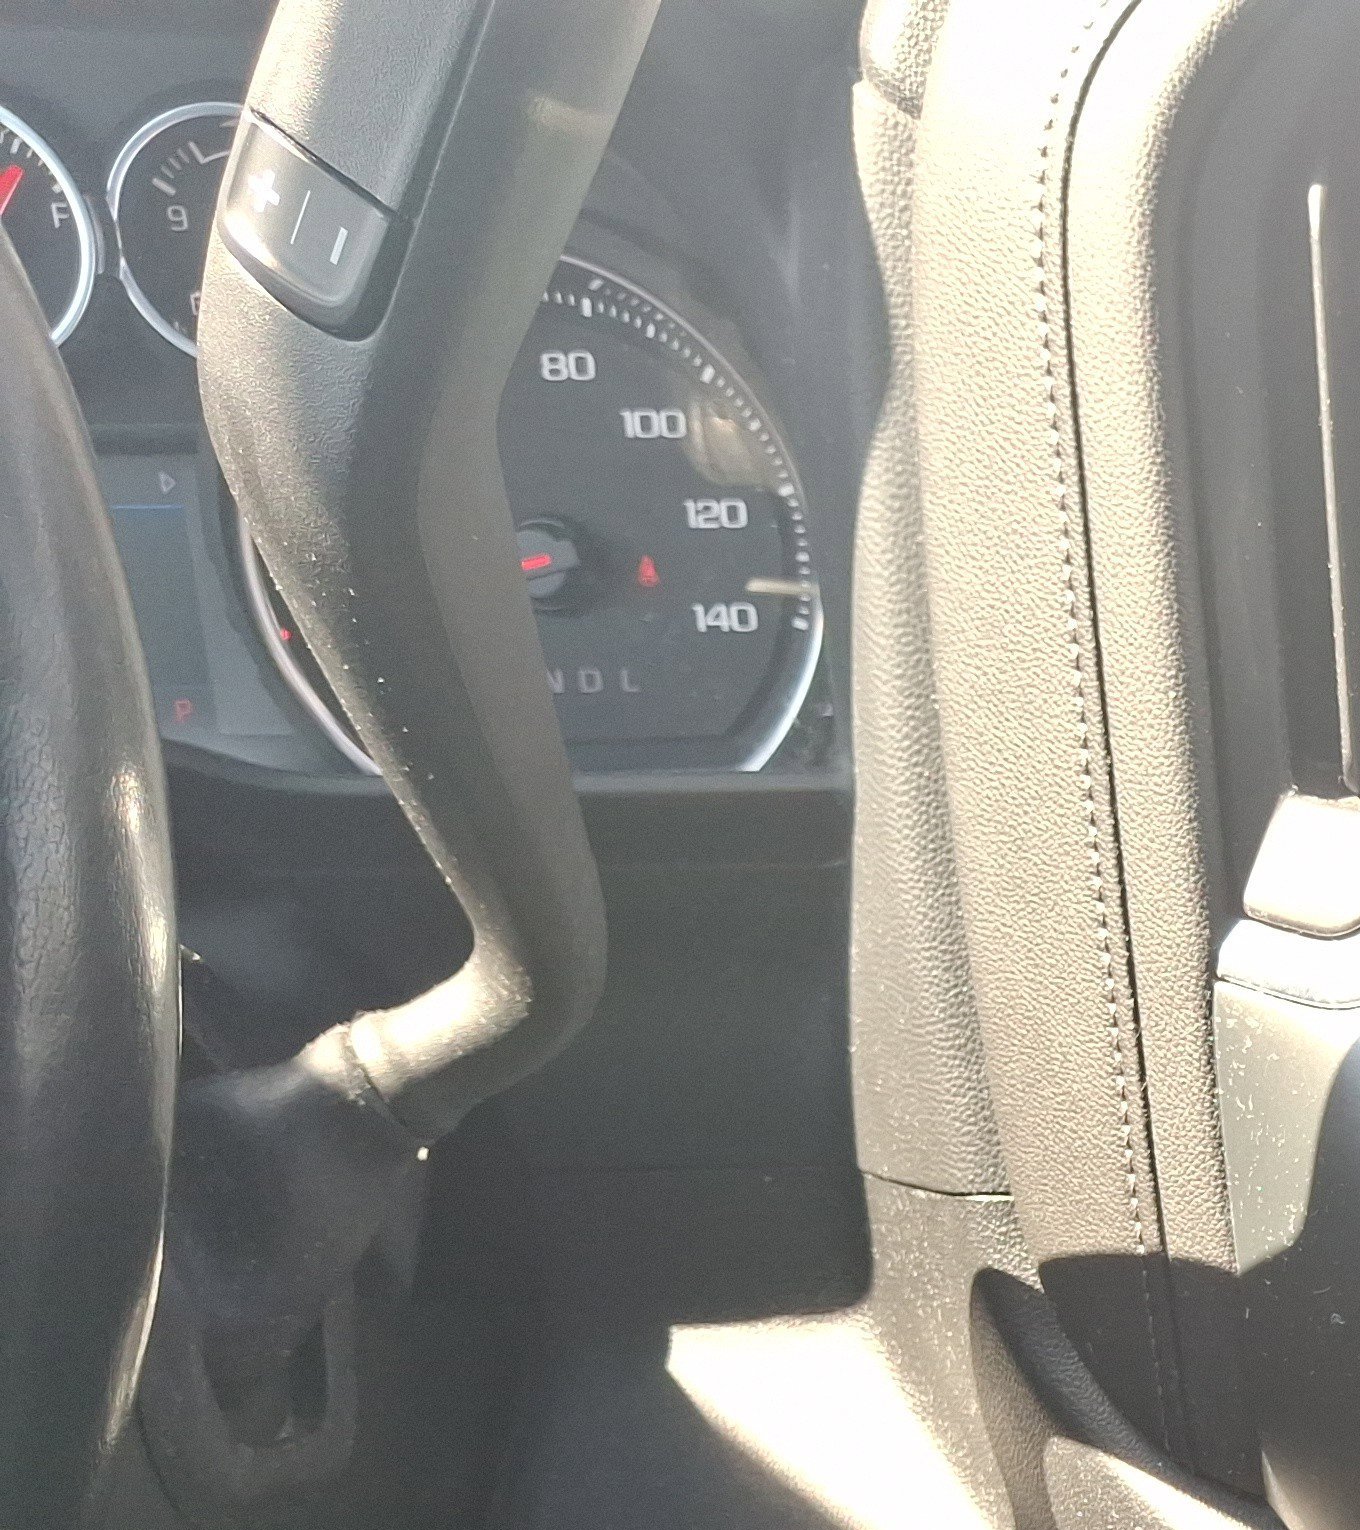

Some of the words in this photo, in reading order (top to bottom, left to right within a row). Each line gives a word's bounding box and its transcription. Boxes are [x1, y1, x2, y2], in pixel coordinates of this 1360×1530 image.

[51, 202, 69, 228] F
[540, 350, 596, 381] 80
[619, 408, 687, 438] 100
[684, 498, 748, 528] 120
[692, 602, 758, 632] 140
